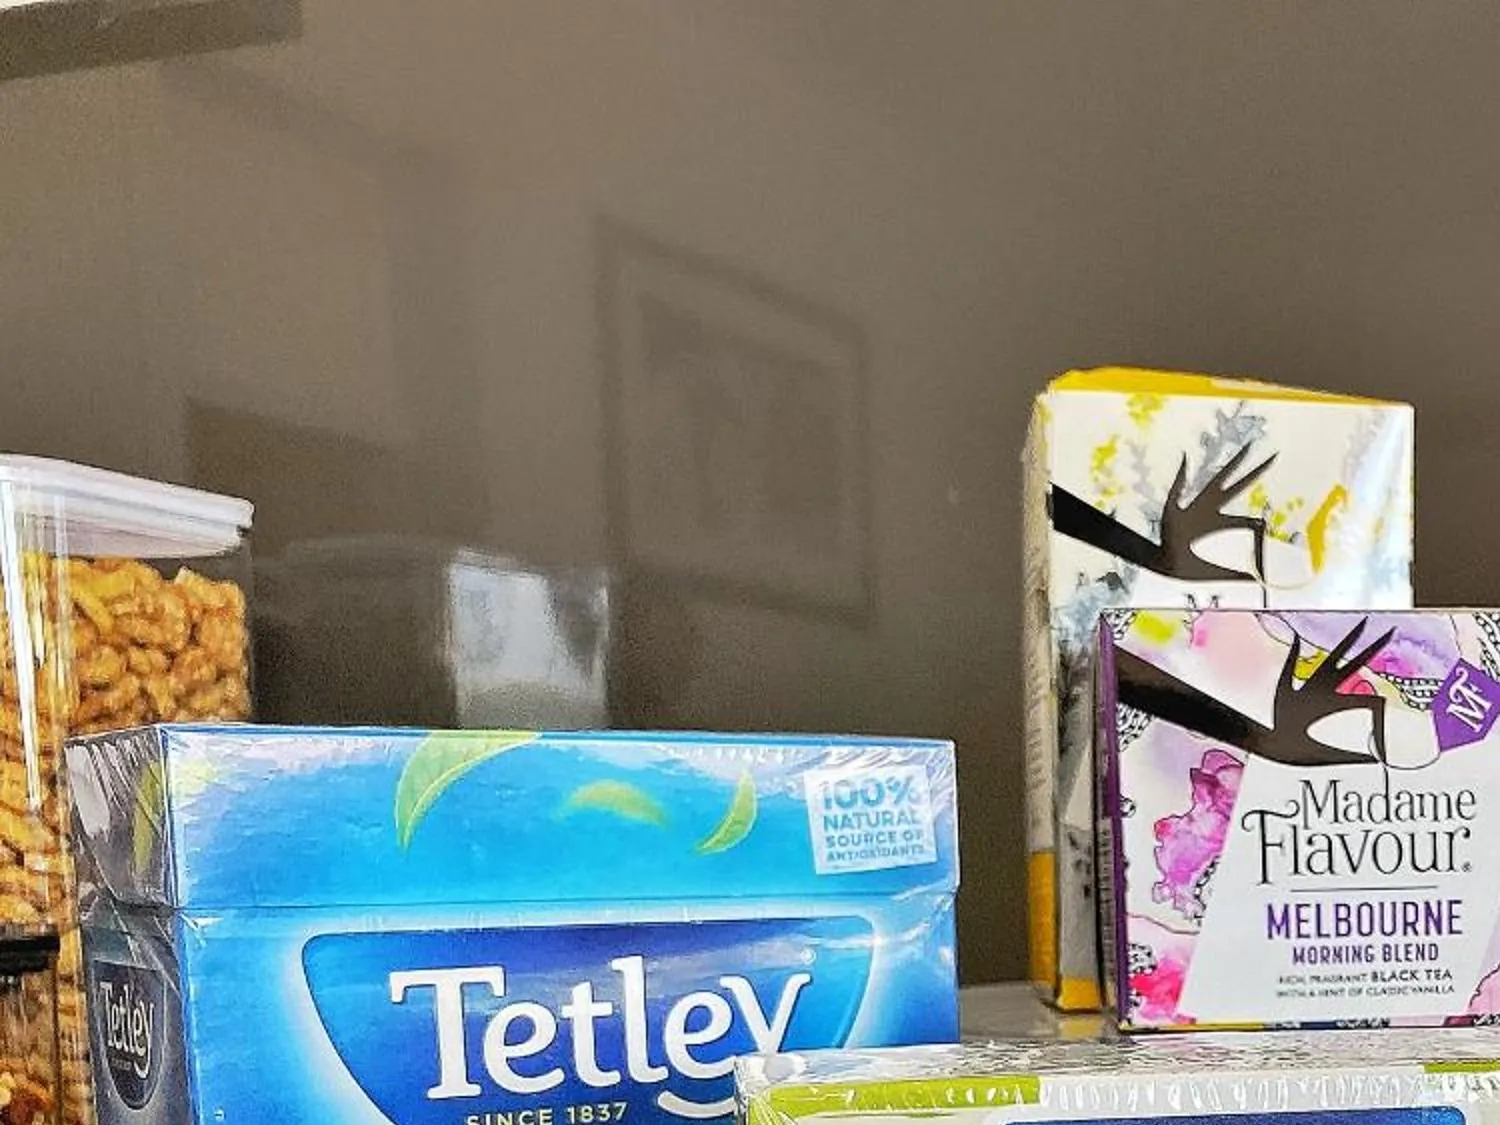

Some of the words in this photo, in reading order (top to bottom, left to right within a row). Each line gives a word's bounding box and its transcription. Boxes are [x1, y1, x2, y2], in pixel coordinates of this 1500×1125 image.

[818, 775, 925, 811] 100%
[1299, 776, 1478, 831] Madame
[822, 809, 923, 832] NATURAL
[825, 830, 897, 849] SOURCE
[902, 829, 924, 842] OF
[1241, 799, 1473, 886] Flavour
[1266, 899, 1463, 940] MELBOURNE
[1292, 944, 1375, 966] MORNING
[1381, 943, 1440, 964] BLEND
[1371, 969, 1420, 983] BLACK
[1423, 969, 1453, 981] TEA
[99, 980, 155, 1079] Tetley
[389, 954, 811, 1119] Tetley
[567, 1101, 629, 1124] 1837
